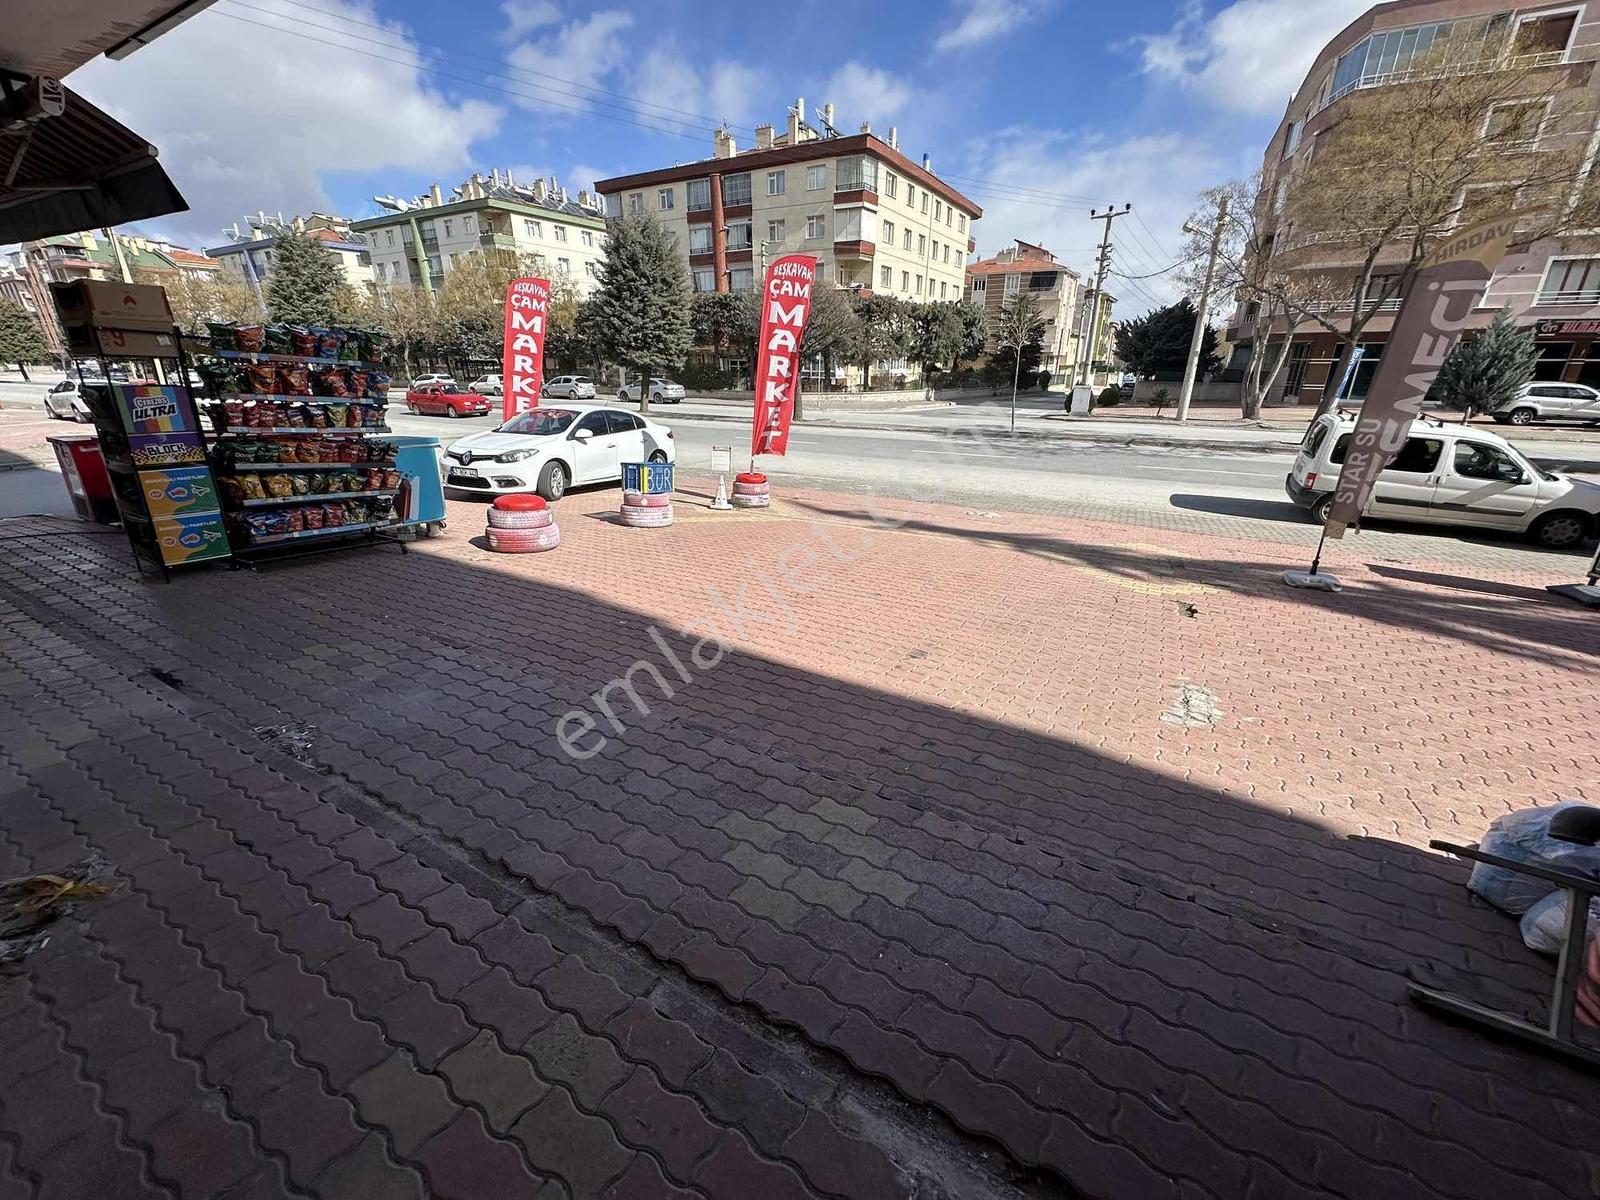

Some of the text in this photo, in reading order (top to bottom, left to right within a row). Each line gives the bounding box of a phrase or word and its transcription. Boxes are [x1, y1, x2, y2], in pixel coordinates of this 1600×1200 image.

[769, 279, 810, 299] ÇAM
[511, 294, 546, 312] ÇAM
[760, 300, 806, 449] MARKET
[134, 403, 177, 421] ULTRA
[145, 443, 186, 456] BLOCK
[1335, 418, 1382, 504] STAR SU
